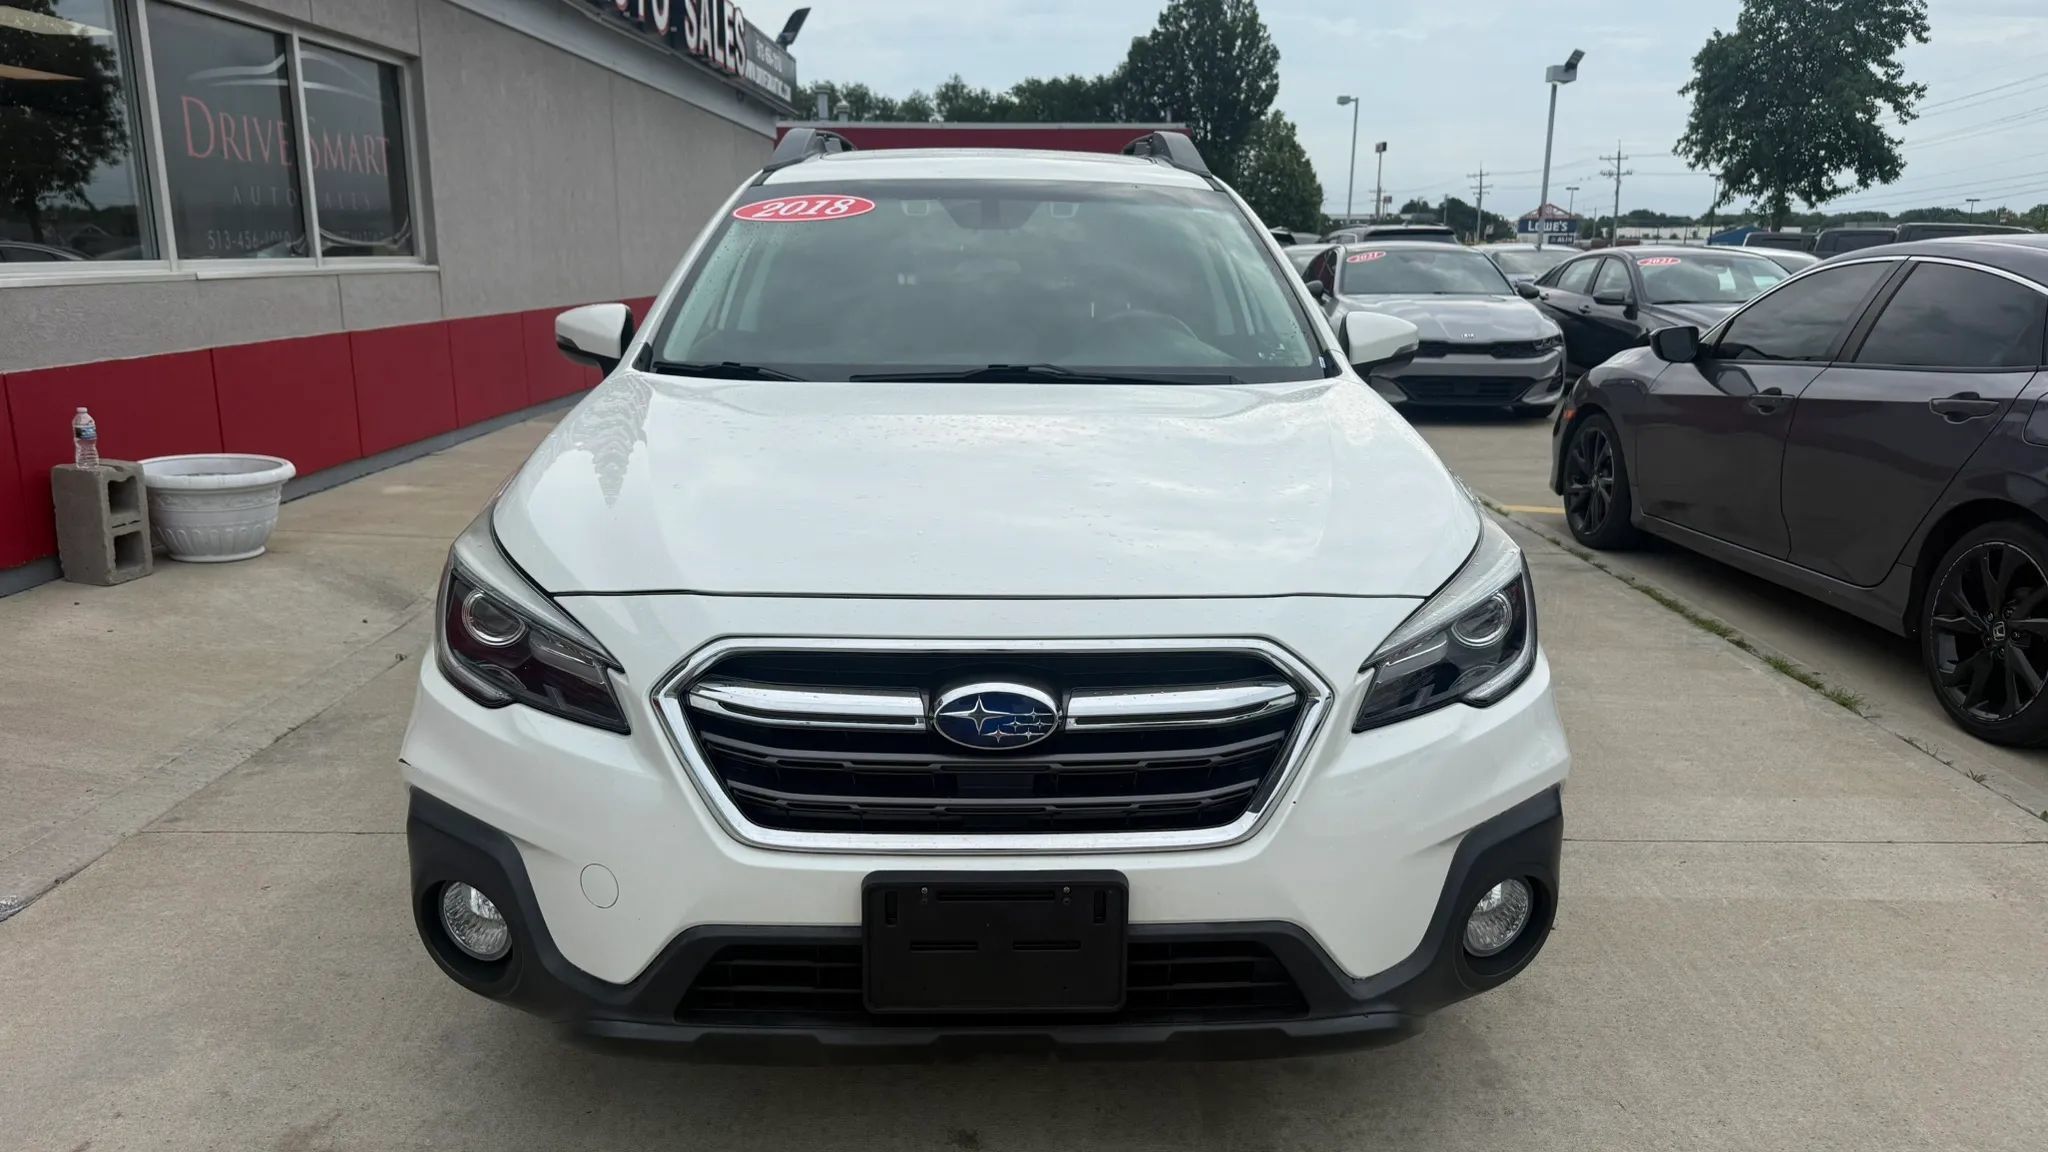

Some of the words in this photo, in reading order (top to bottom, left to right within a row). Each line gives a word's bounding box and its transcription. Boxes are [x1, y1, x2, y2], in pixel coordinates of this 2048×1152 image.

[684, 0, 747, 78] SALES
[181, 96, 292, 166] DRIVE
[752, 199, 855, 218] 2018
